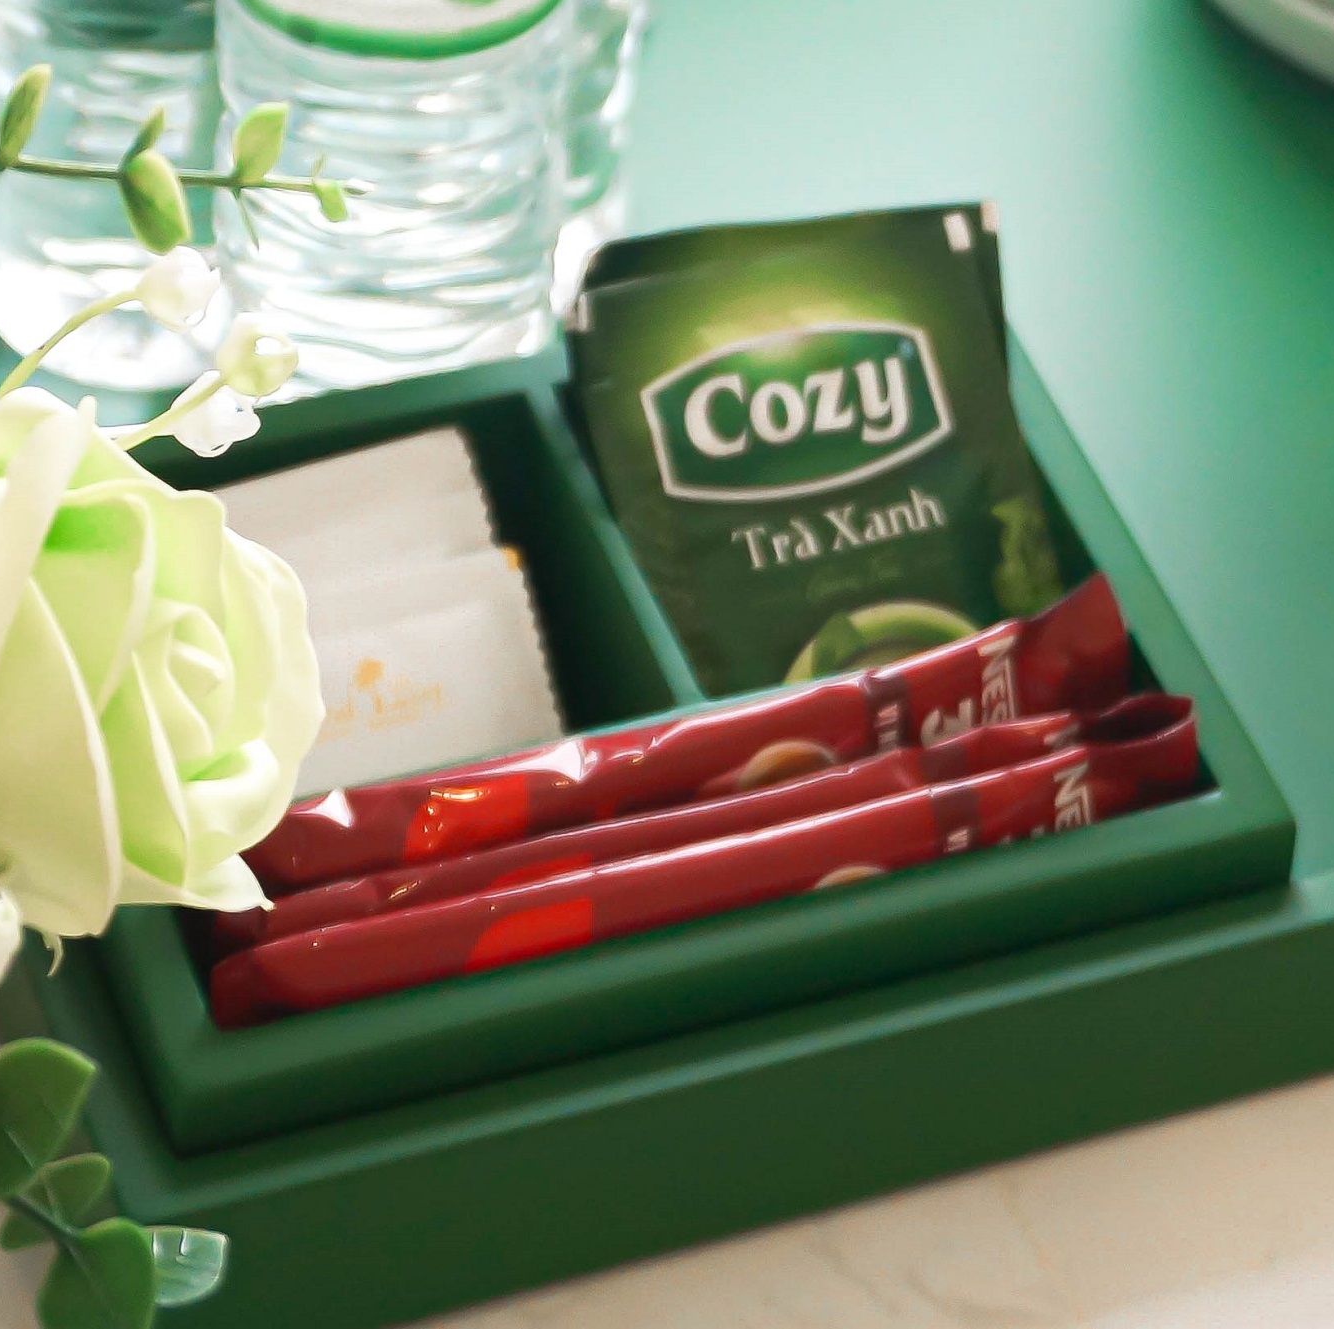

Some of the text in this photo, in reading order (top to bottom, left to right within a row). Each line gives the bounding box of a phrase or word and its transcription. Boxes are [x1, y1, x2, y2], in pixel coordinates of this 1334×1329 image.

[683, 356, 909, 458] Cozy
[730, 486, 945, 571] Trà Xanh
